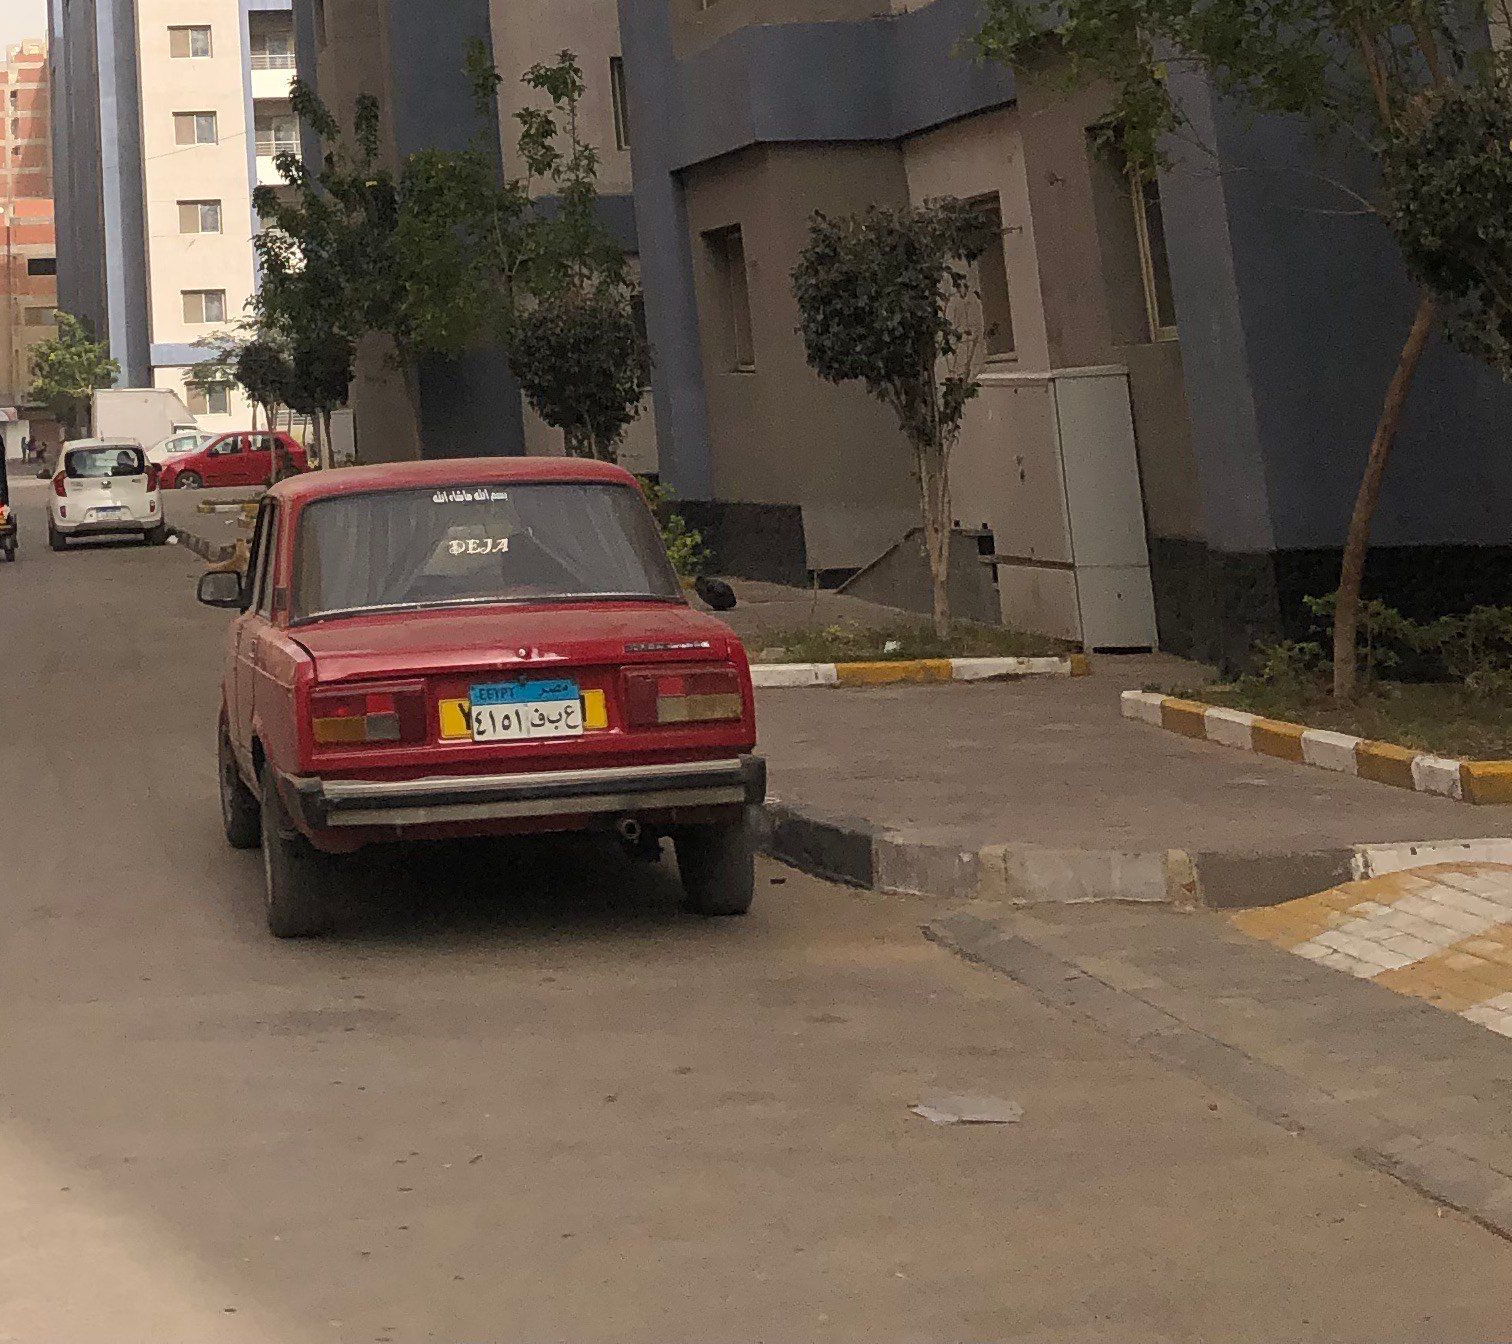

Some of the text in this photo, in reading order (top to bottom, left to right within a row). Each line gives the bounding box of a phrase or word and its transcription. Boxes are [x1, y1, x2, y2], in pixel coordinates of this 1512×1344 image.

[433, 491, 448, 503] الله
[474, 489, 489, 501] الله
[449, 538, 509, 555] DEJA
[479, 686, 515, 701] EGYPT
[537, 684, 569, 697] مصر
